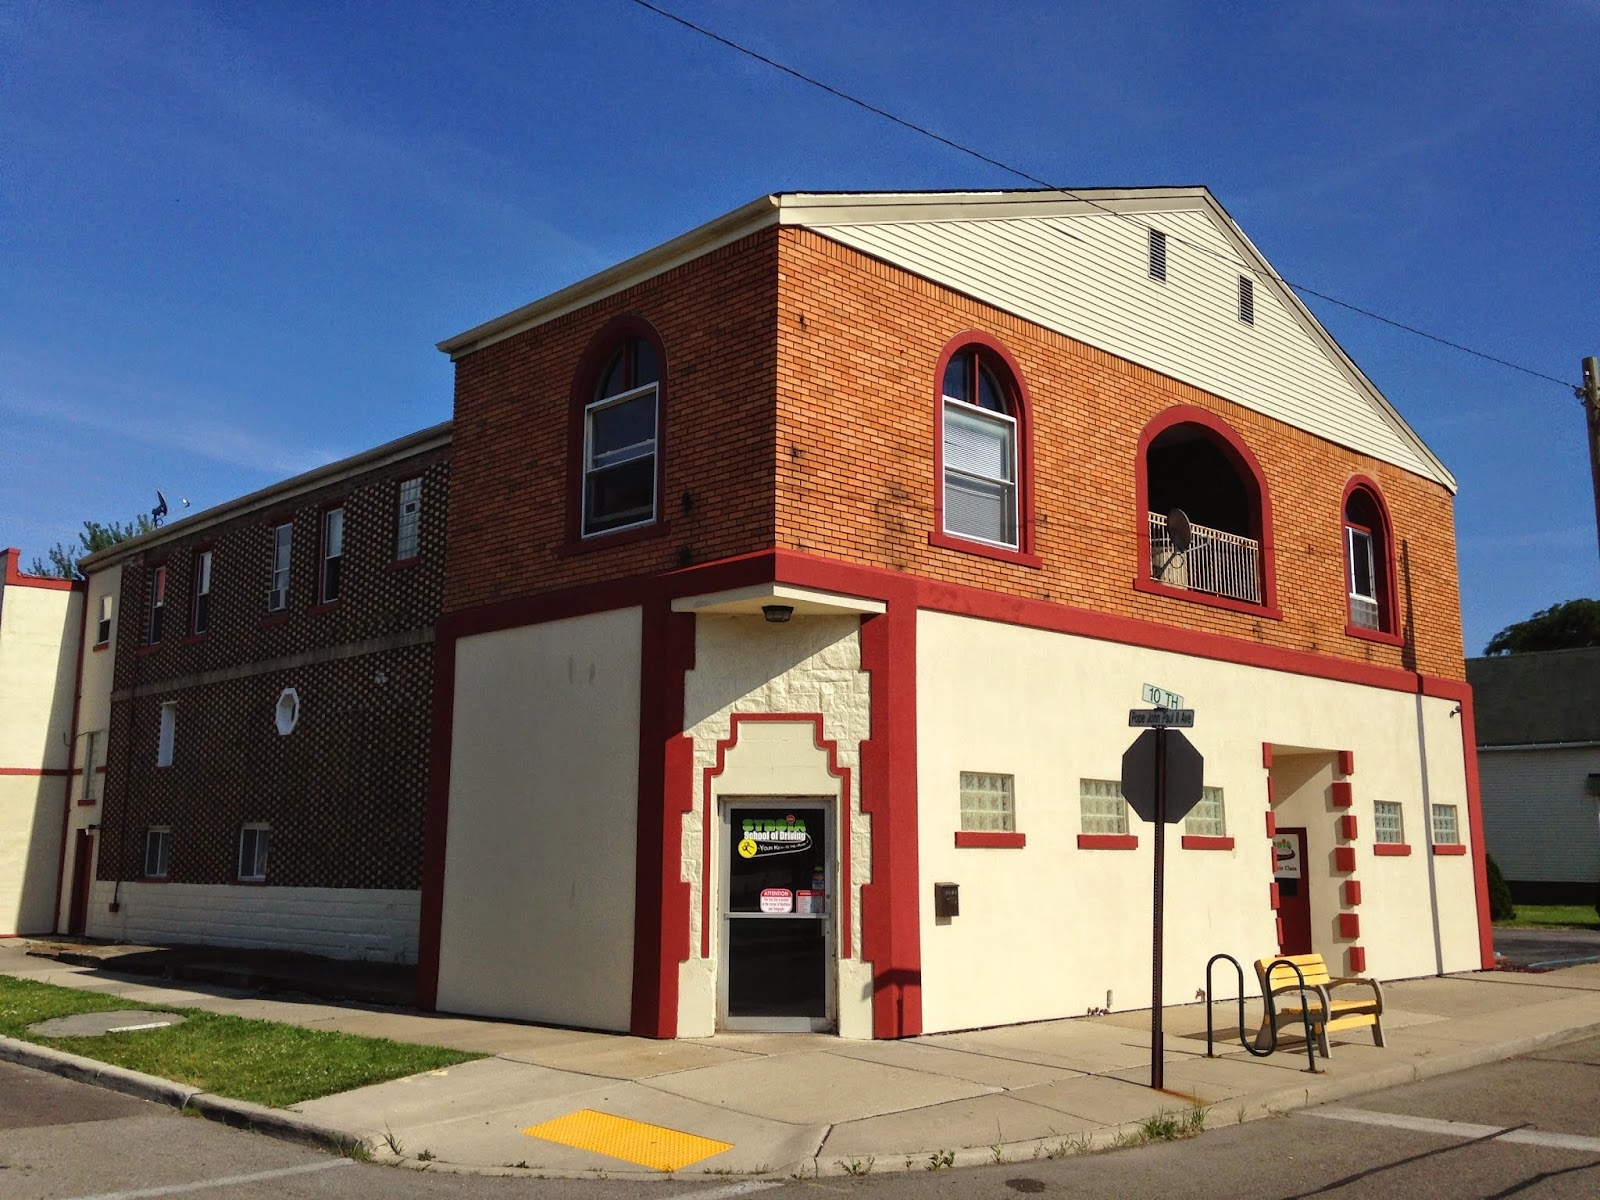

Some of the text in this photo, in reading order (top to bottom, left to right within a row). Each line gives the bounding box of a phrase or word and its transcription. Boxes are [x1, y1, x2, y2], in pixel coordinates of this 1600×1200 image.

[1149, 688, 1179, 709] 10 TH
[1131, 711, 1146, 726] Pope
[1147, 711, 1160, 724] John
[1162, 711, 1174, 724] Paul
[1181, 712, 1192, 724] Ave
[744, 831, 806, 841] School of Driving
